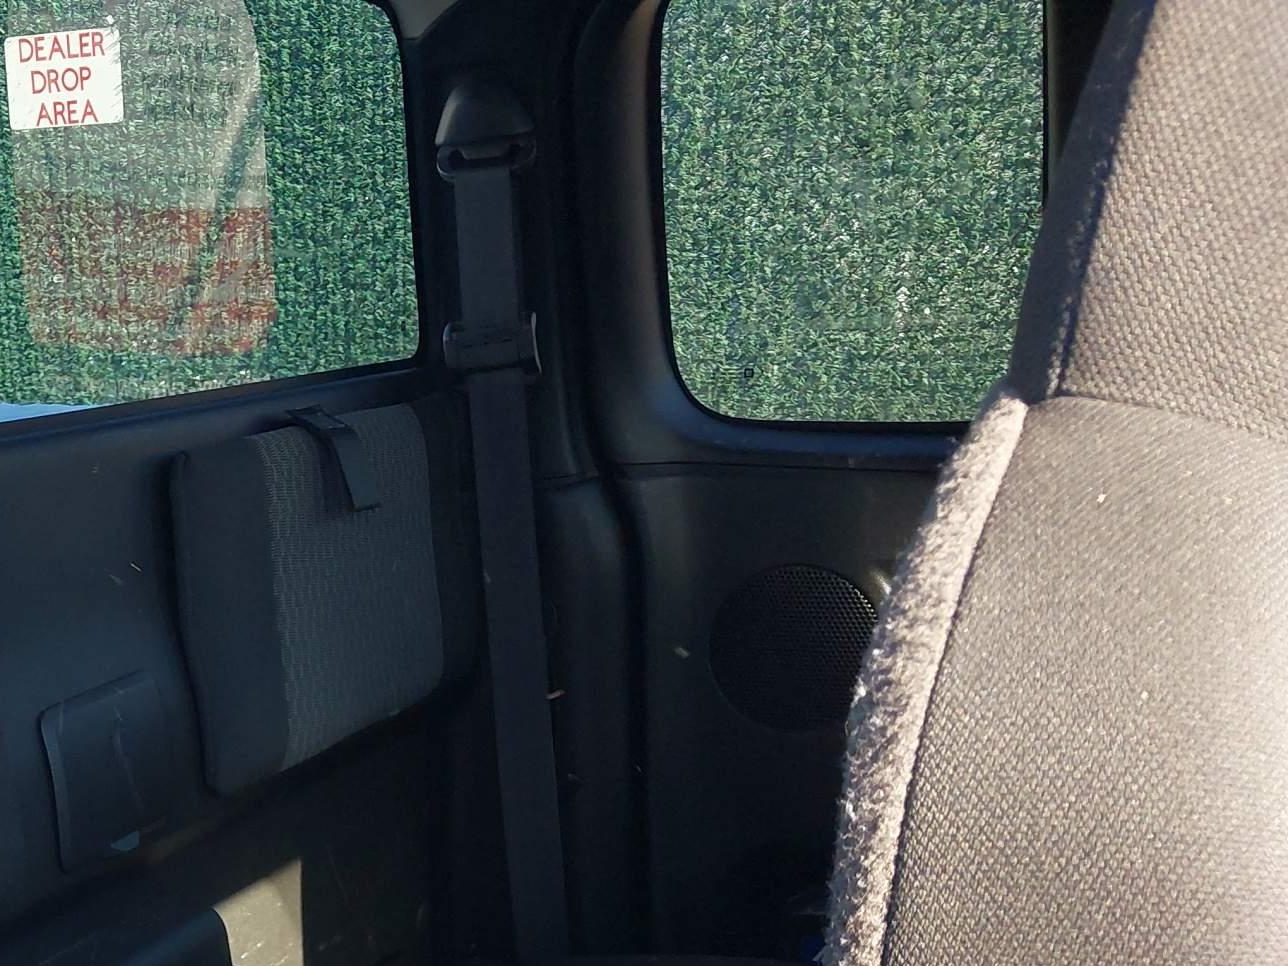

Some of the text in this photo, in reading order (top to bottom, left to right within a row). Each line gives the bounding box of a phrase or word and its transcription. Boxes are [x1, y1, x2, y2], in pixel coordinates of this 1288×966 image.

[18, 31, 105, 63] DEALER
[30, 66, 91, 94] DROP
[36, 99, 99, 127] AREA
